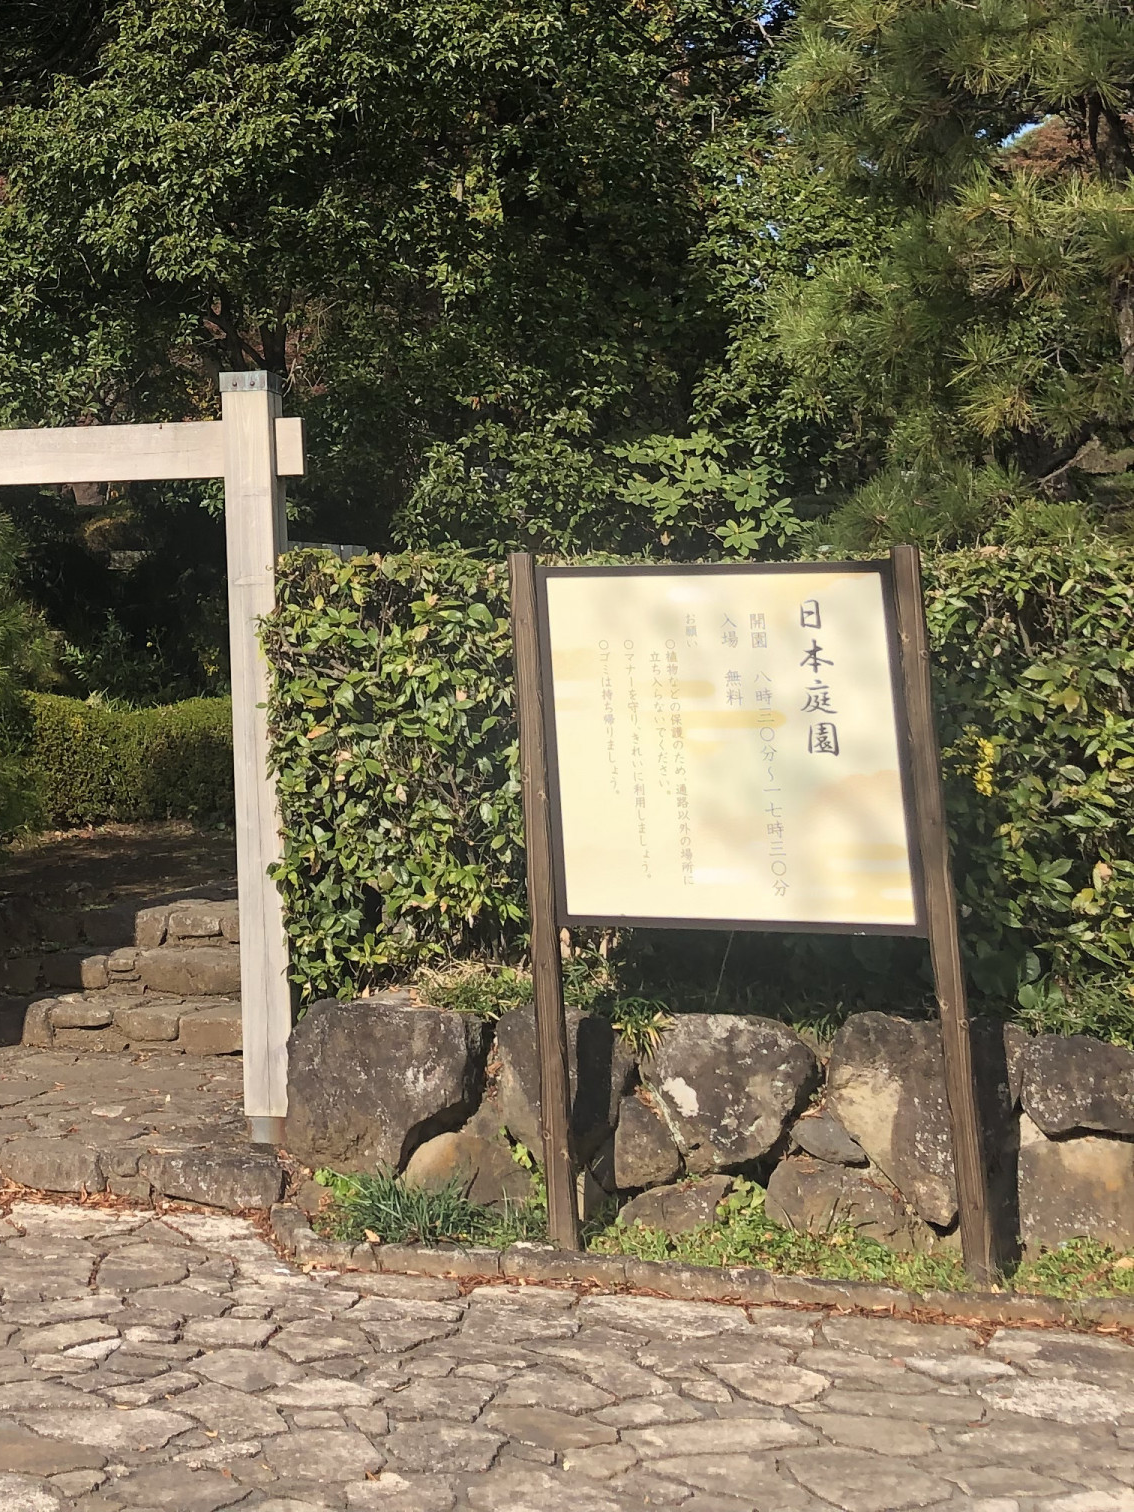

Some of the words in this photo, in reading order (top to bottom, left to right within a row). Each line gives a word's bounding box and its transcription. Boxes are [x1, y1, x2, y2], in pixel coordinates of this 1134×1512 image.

[684, 613, 699, 649] お願い
[720, 612, 739, 650] 入場
[749, 612, 768, 650] 開園
[724, 668, 744, 706] 無料
[798, 598, 841, 758] 日本庭園
[648, 651, 672, 796] 立ち入らないでください。
